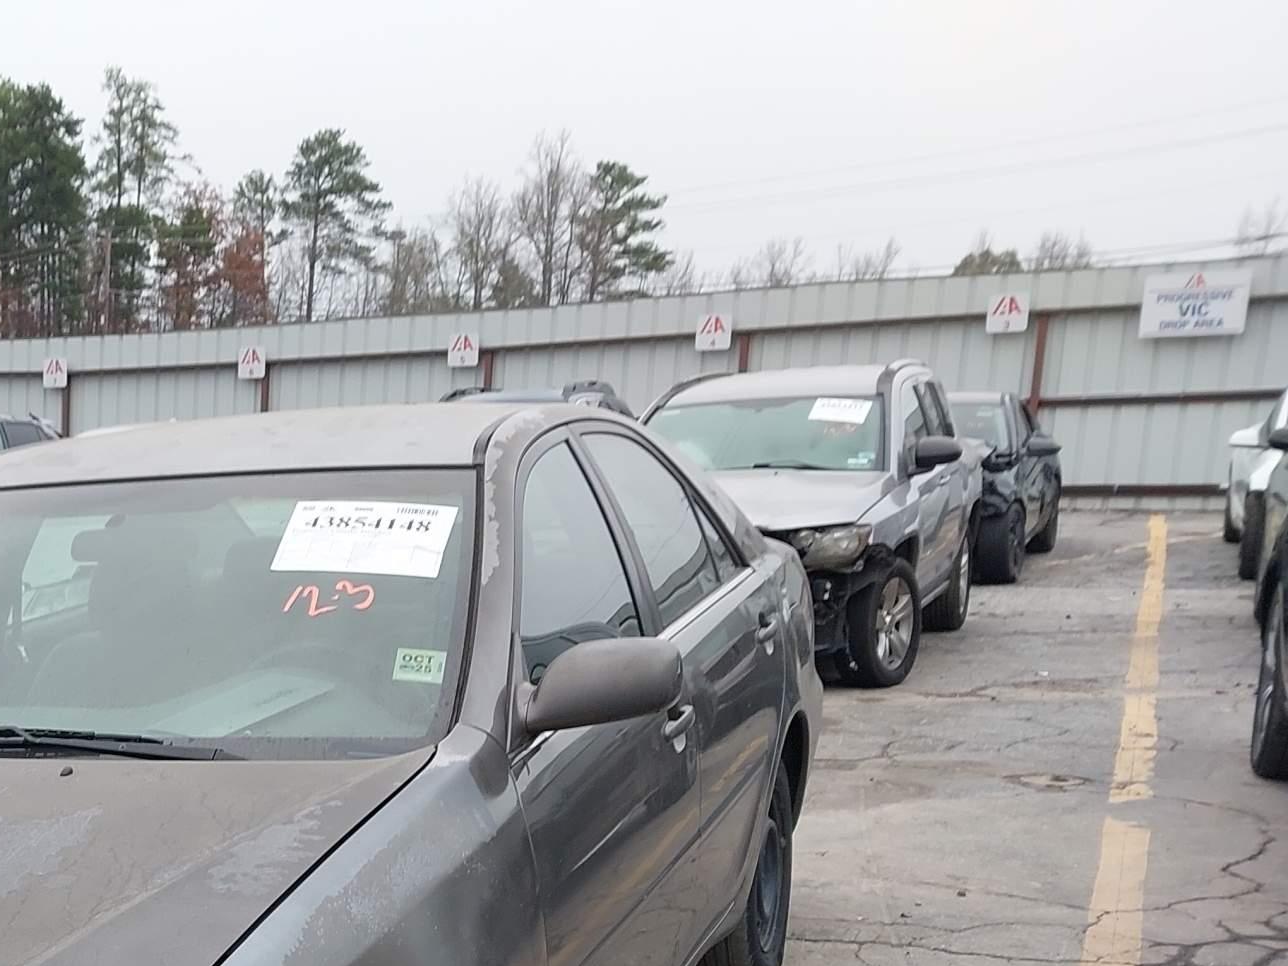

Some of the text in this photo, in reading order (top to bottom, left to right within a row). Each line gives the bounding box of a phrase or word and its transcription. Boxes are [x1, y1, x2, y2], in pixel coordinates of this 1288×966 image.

[1179, 302, 1210, 317] VIC
[1193, 317, 1224, 329] AREA
[304, 515, 433, 533] 43854148
[402, 653, 434, 664] OCT
